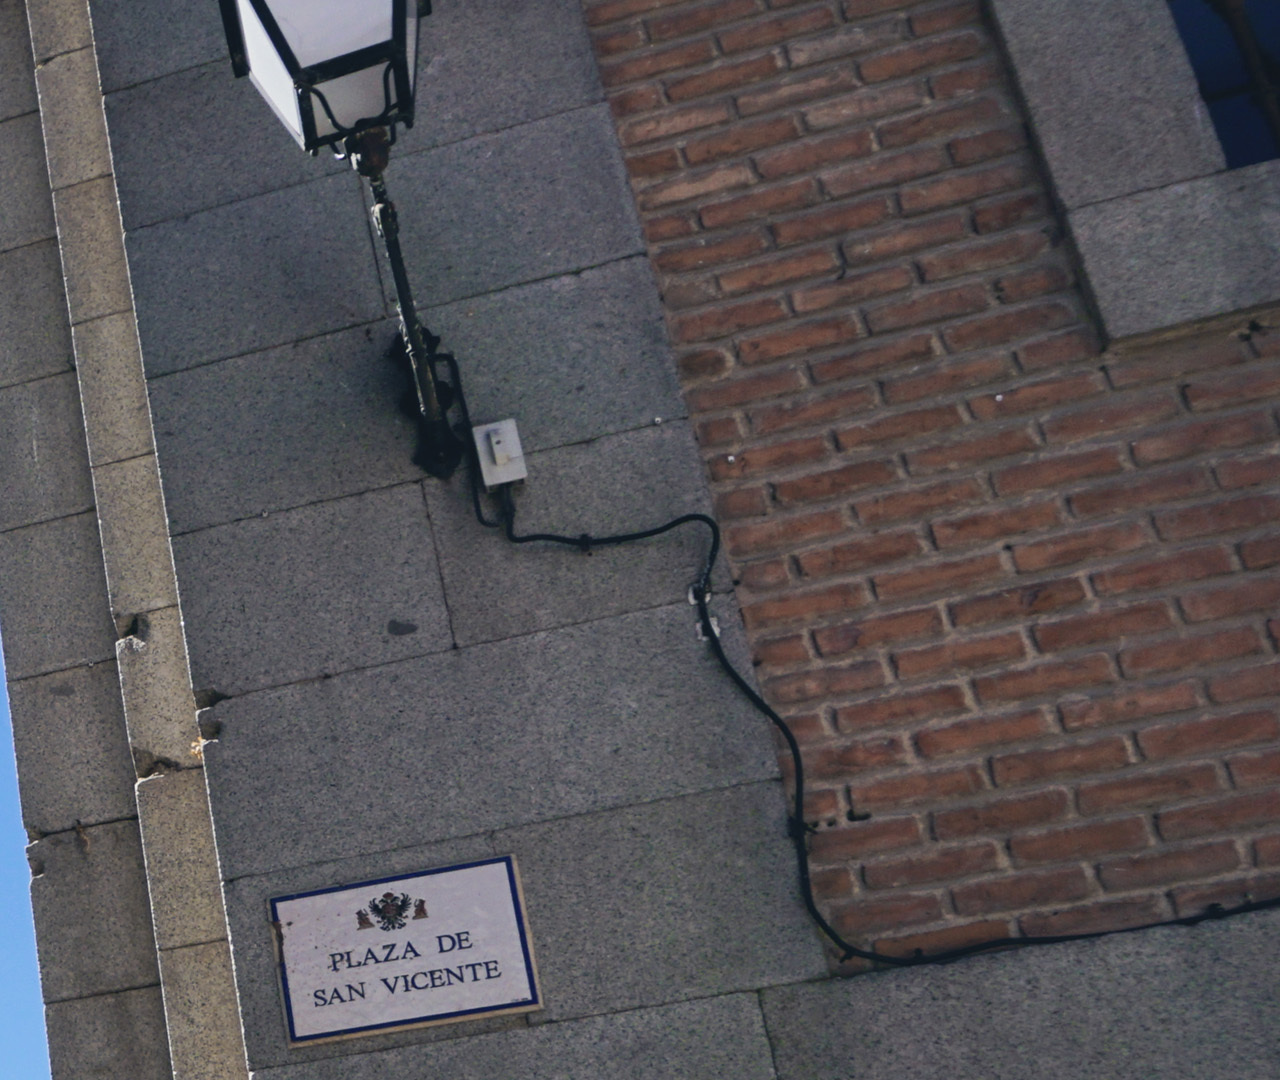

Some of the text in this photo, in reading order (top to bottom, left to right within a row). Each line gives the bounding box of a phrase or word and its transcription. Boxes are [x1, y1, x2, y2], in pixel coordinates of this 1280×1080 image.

[328, 931, 473, 972] PLAZA DE
[313, 960, 503, 1008] SAN VICENTE
